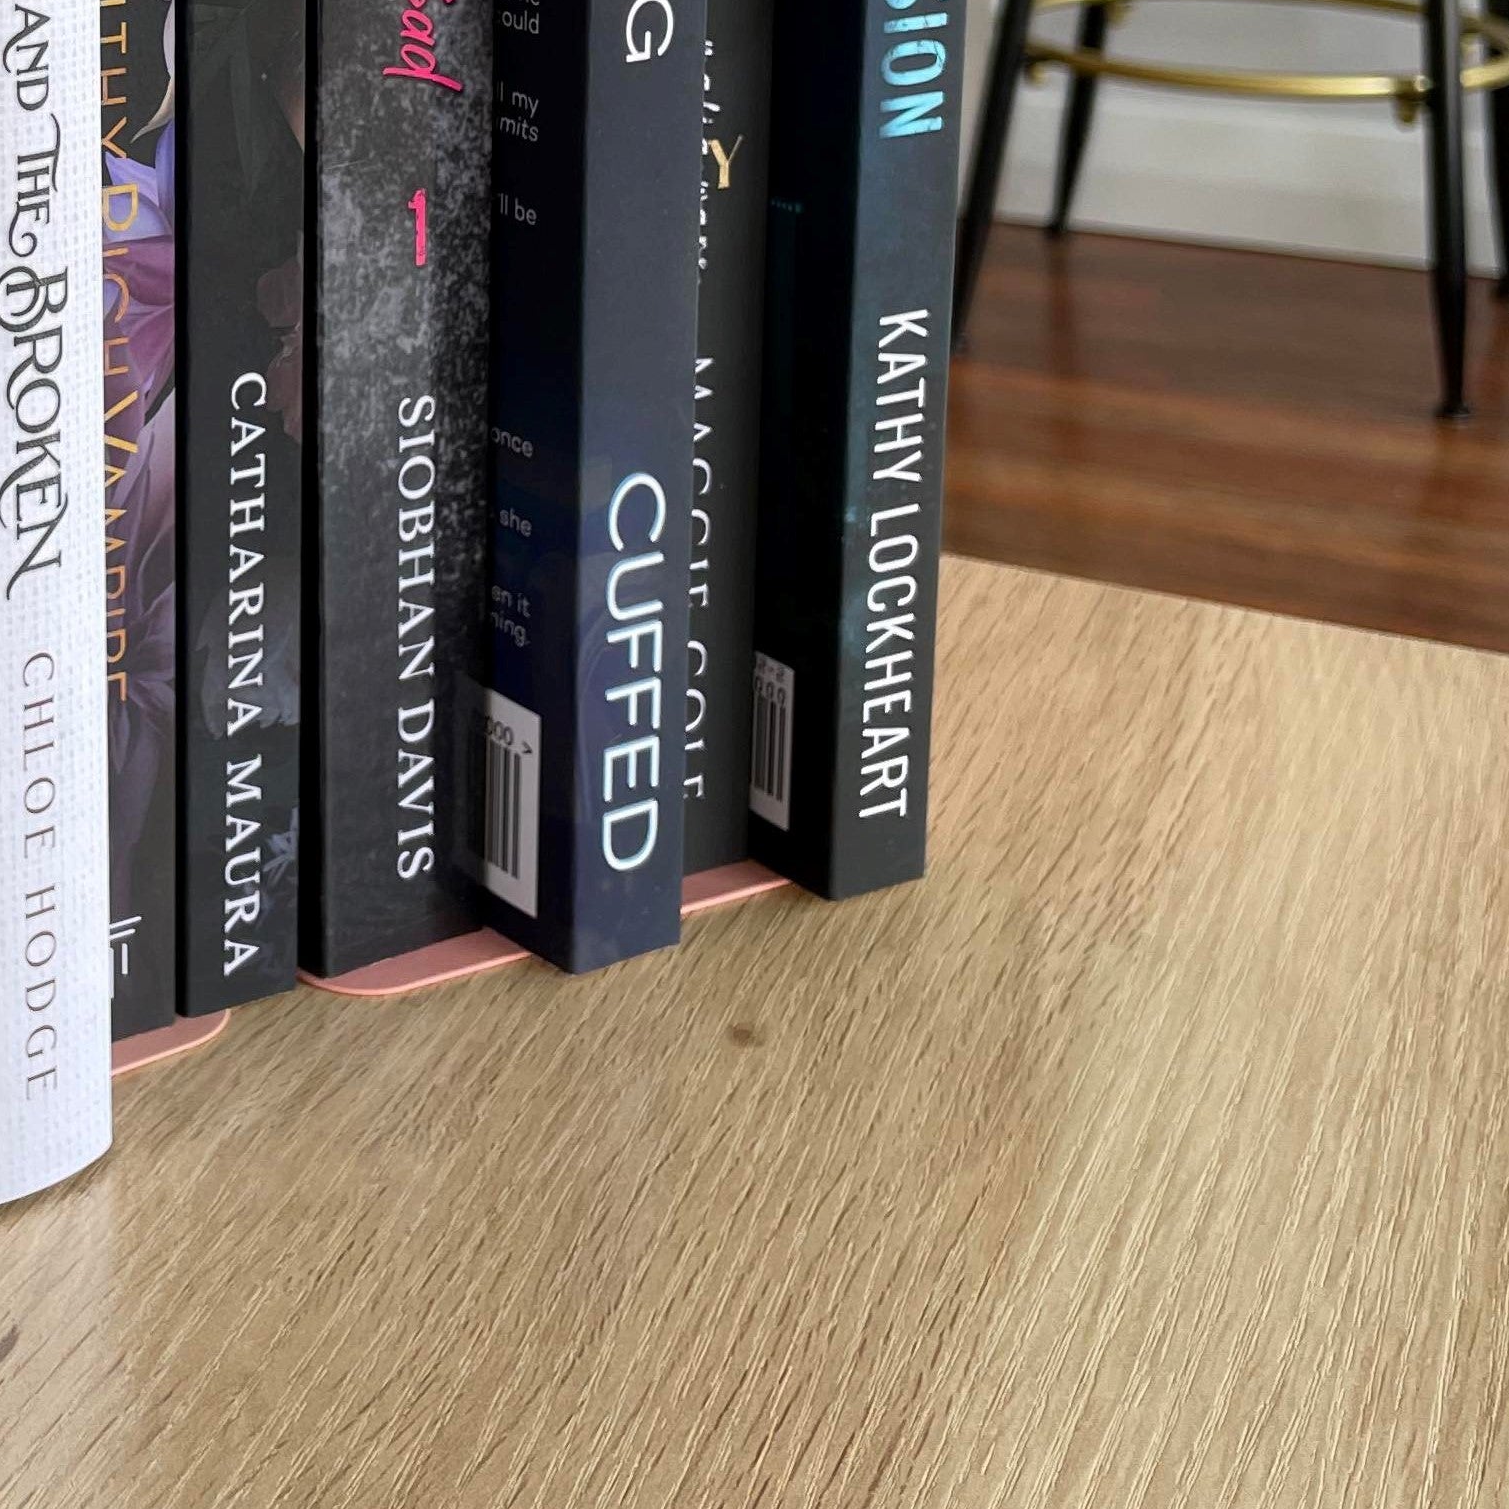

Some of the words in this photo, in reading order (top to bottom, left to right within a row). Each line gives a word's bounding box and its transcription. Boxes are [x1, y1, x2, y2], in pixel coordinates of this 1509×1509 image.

[1, 3, 51, 112] AND
[496, 9, 540, 35] ould
[511, 90, 540, 119] my
[8, 114, 62, 258] THE
[407, 187, 428, 267] 1
[514, 197, 538, 226] be
[871, 307, 929, 483] KATHY
[227, 371, 268, 739] CATHARINA
[397, 393, 436, 681] SIOBHAN
[601, 471, 668, 872] CUFFED
[858, 502, 922, 819] LOCKHEART
[21, 650, 58, 860] CHLOE
[396, 697, 436, 880] DAVIS
[223, 753, 263, 977] MAURA
[21, 883, 60, 1102] HODGE
